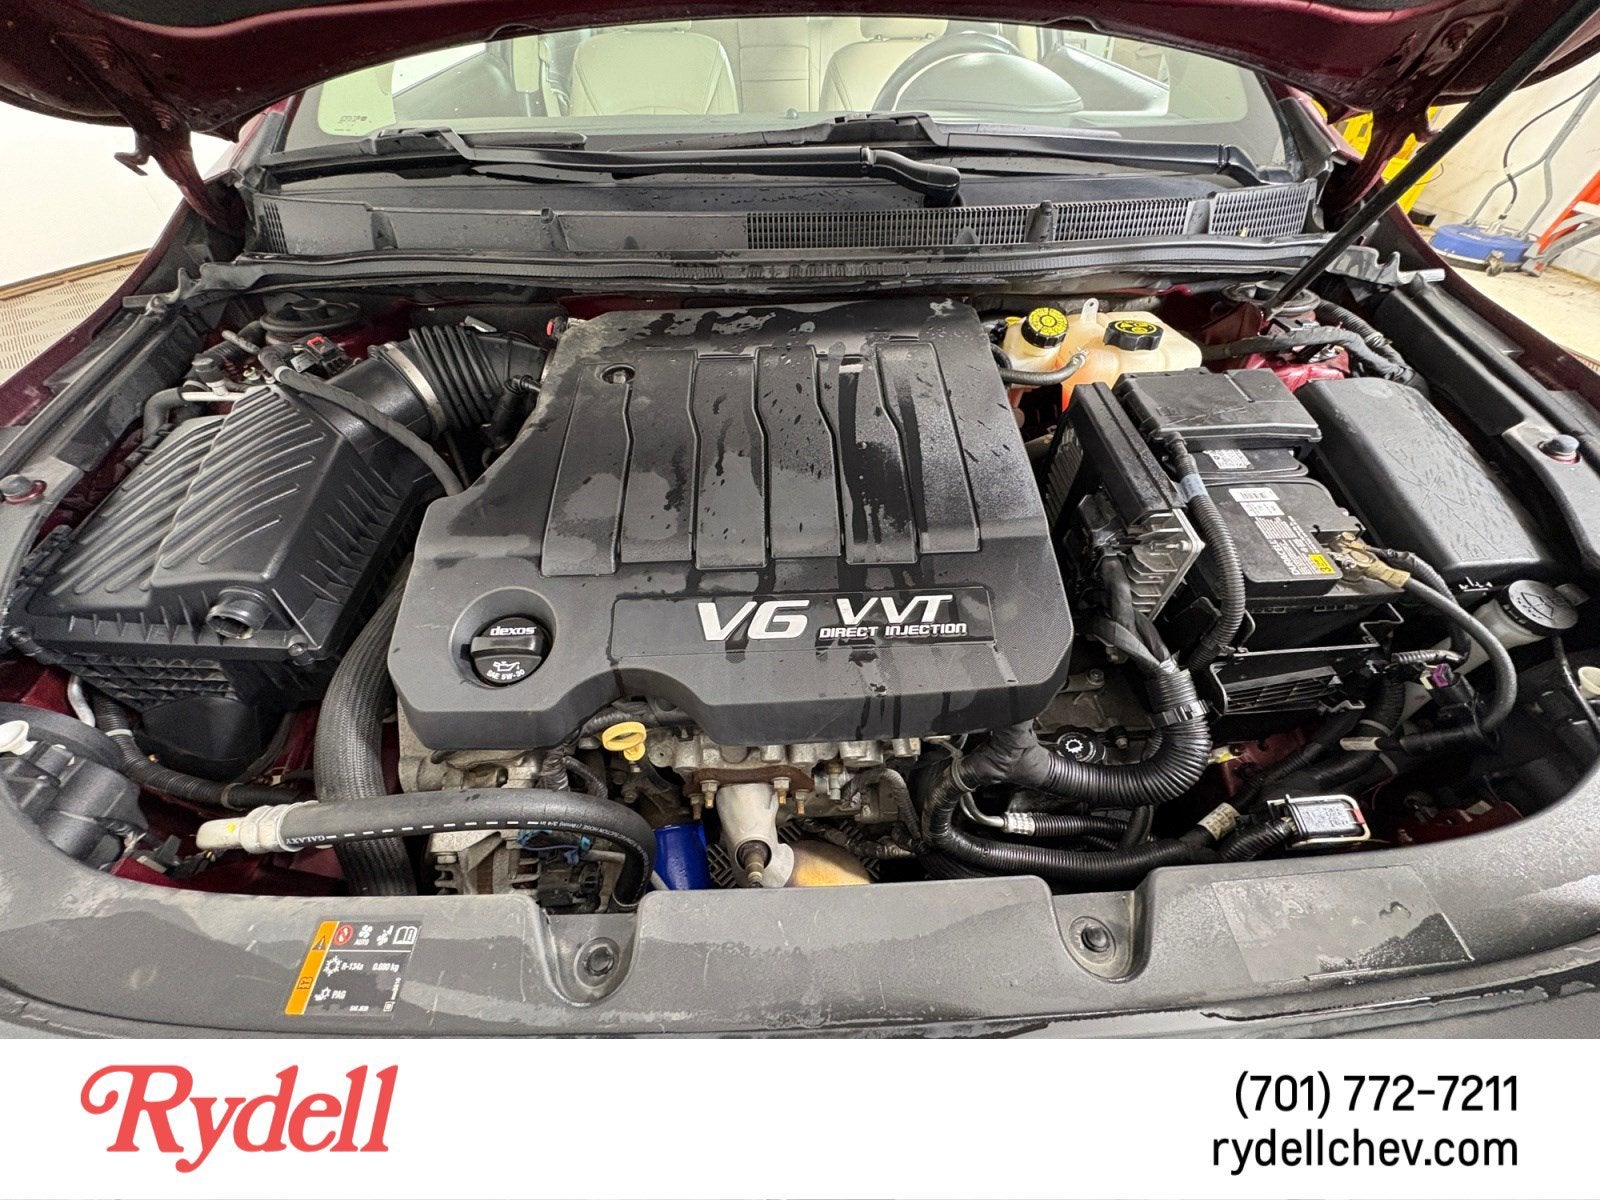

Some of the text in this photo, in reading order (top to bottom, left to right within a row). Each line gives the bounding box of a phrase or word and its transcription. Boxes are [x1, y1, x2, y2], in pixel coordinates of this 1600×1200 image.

[1268, 540, 1300, 576] DURACELL
[698, 594, 953, 641] V6 VVT
[490, 626, 537, 636] dexos
[819, 623, 967, 640] DIRECT INJECTION
[286, 834, 325, 844] GALAXY
[341, 962, 364, 971] R-134a
[390, 962, 400, 973] kg
[331, 990, 347, 1000] PAG
